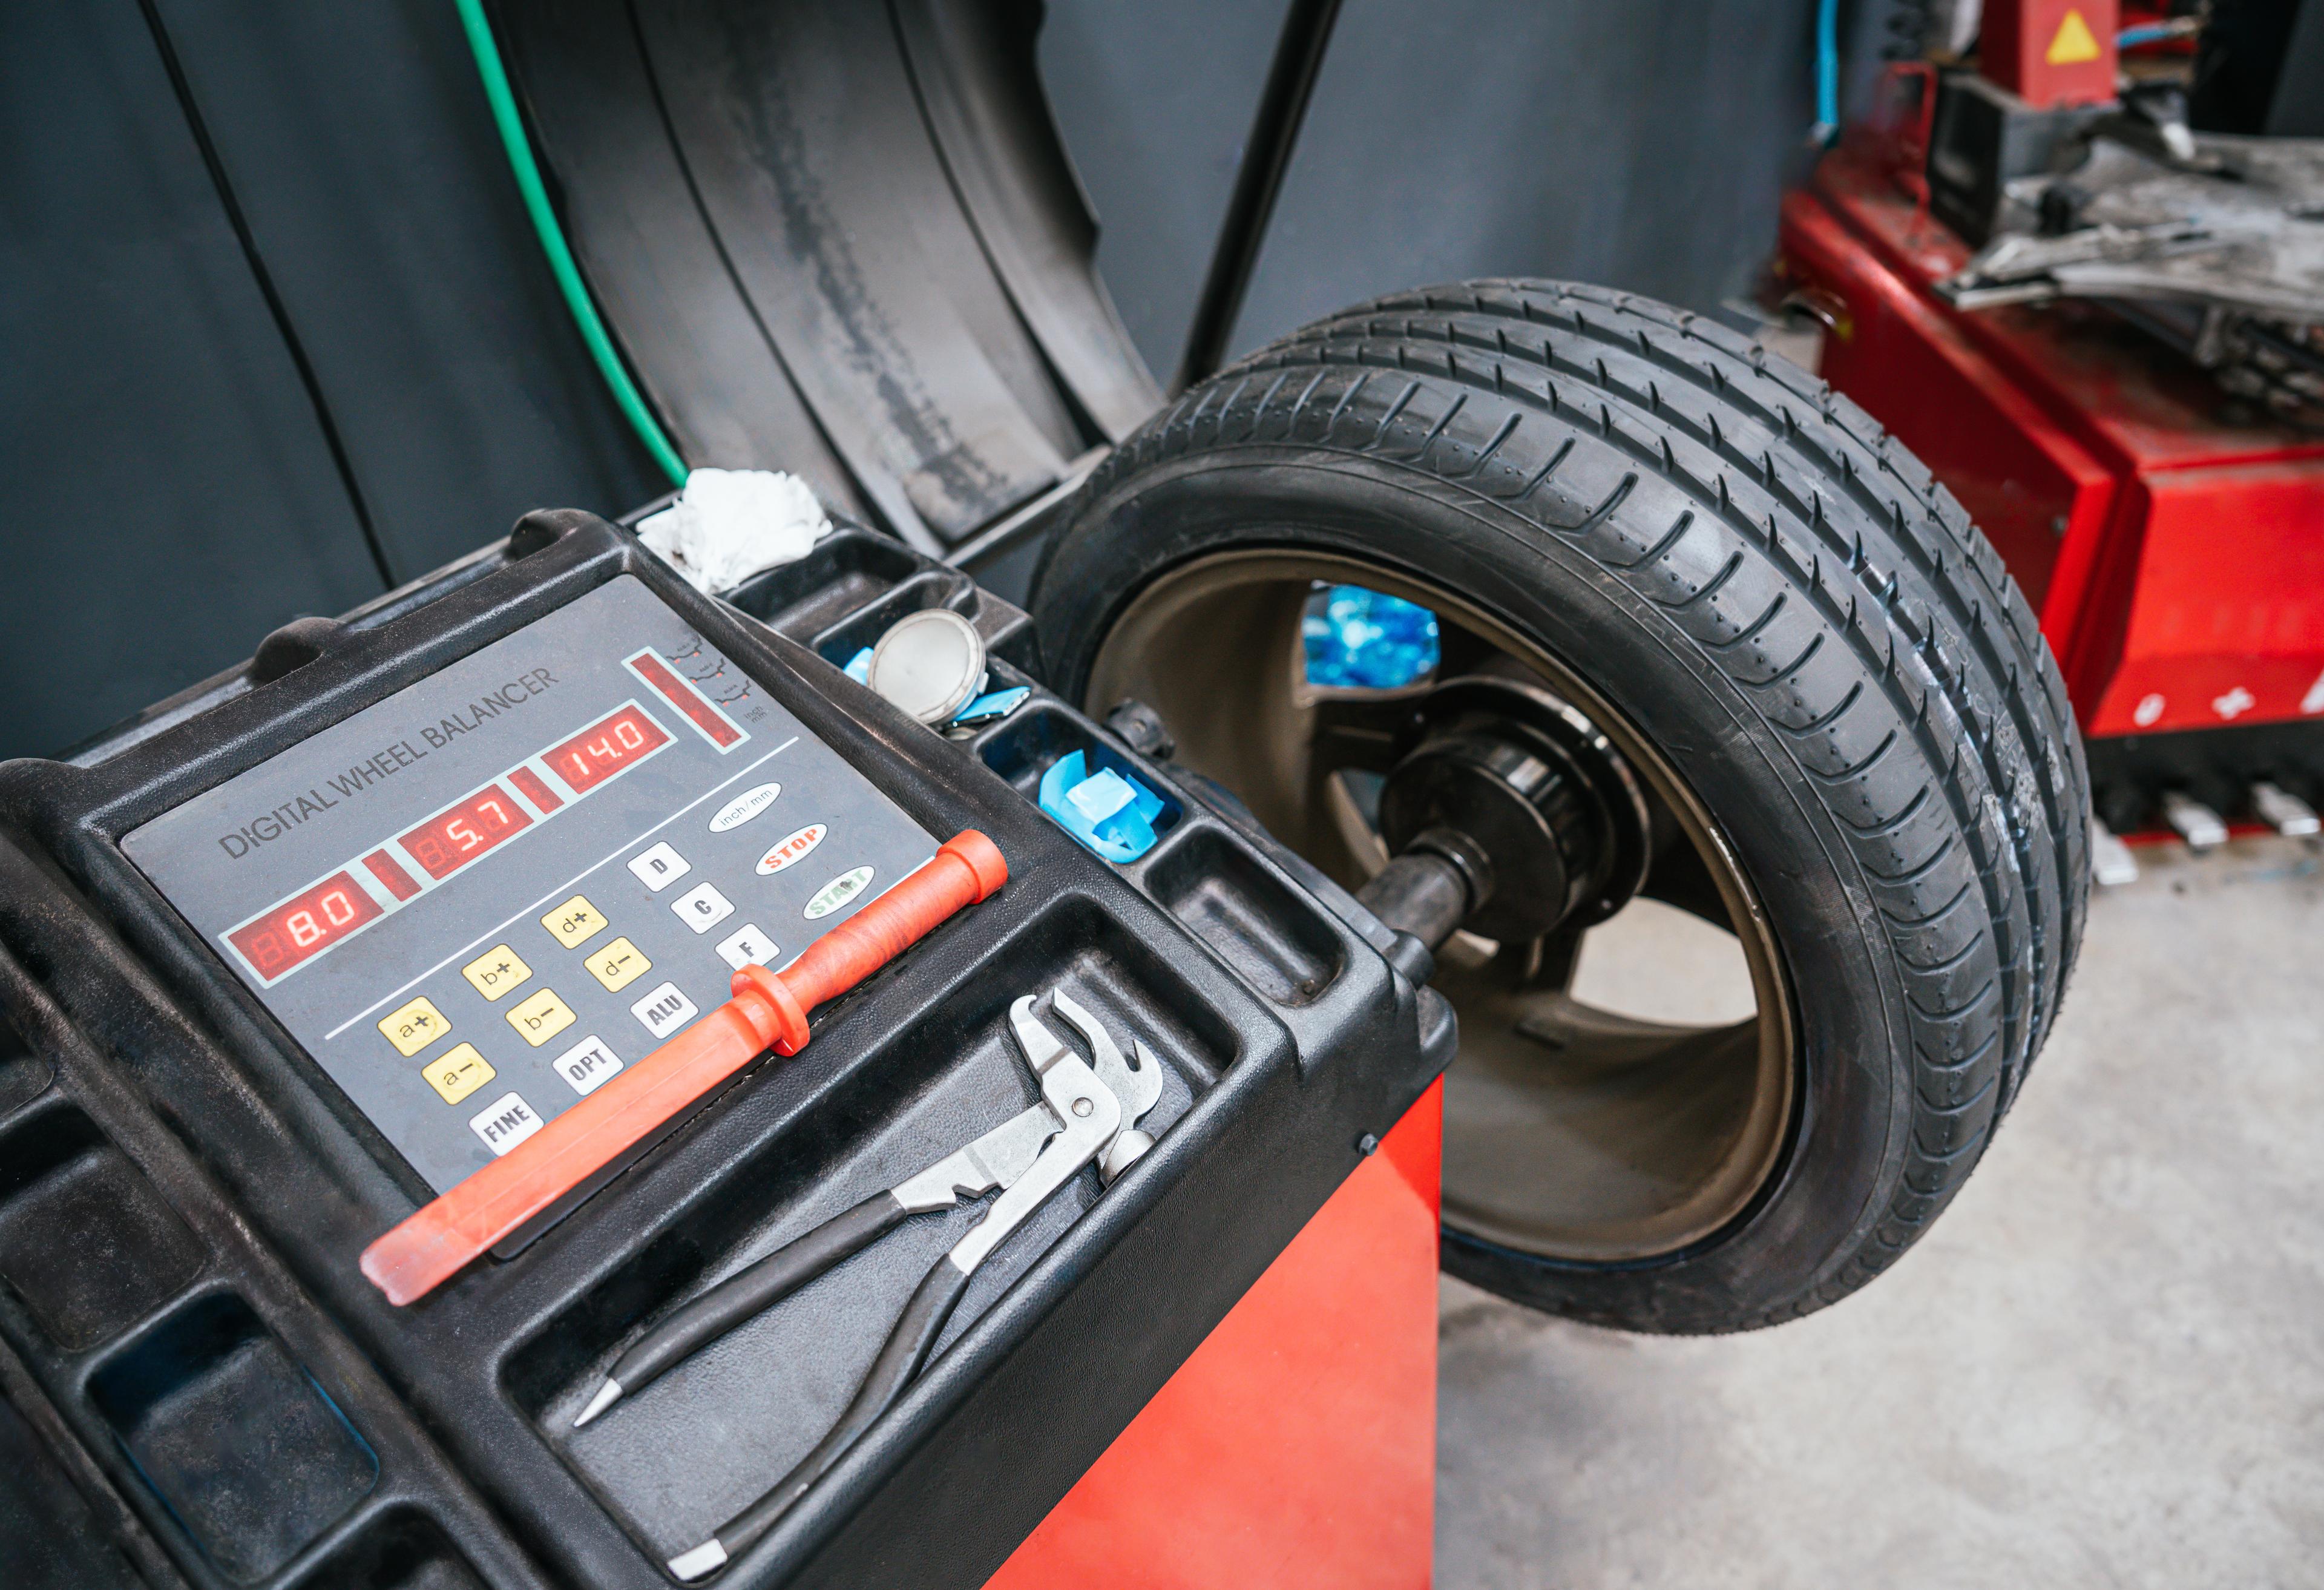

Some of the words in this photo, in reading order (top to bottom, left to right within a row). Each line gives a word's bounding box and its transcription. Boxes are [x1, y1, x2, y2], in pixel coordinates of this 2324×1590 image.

[218, 789, 339, 859] DIGITAL
[327, 740, 427, 798] WHEEL
[420, 668, 559, 749] BALANCER
[572, 720, 644, 775] 14.0
[718, 789, 773, 826] inch/mm
[446, 800, 508, 851] 5.7
[649, 858, 668, 875] D
[765, 829, 818, 869] STOP
[694, 900, 712, 915] C
[809, 869, 867, 915] START
[286, 891, 355, 947] 8.0
[563, 912, 587, 933] d+
[738, 942, 756, 958] F
[481, 963, 510, 985] b+
[399, 1015, 428, 1037] a+
[646, 994, 683, 1026] ALU
[568, 1048, 608, 1082] OPT
[484, 1105, 530, 1143] FINE
